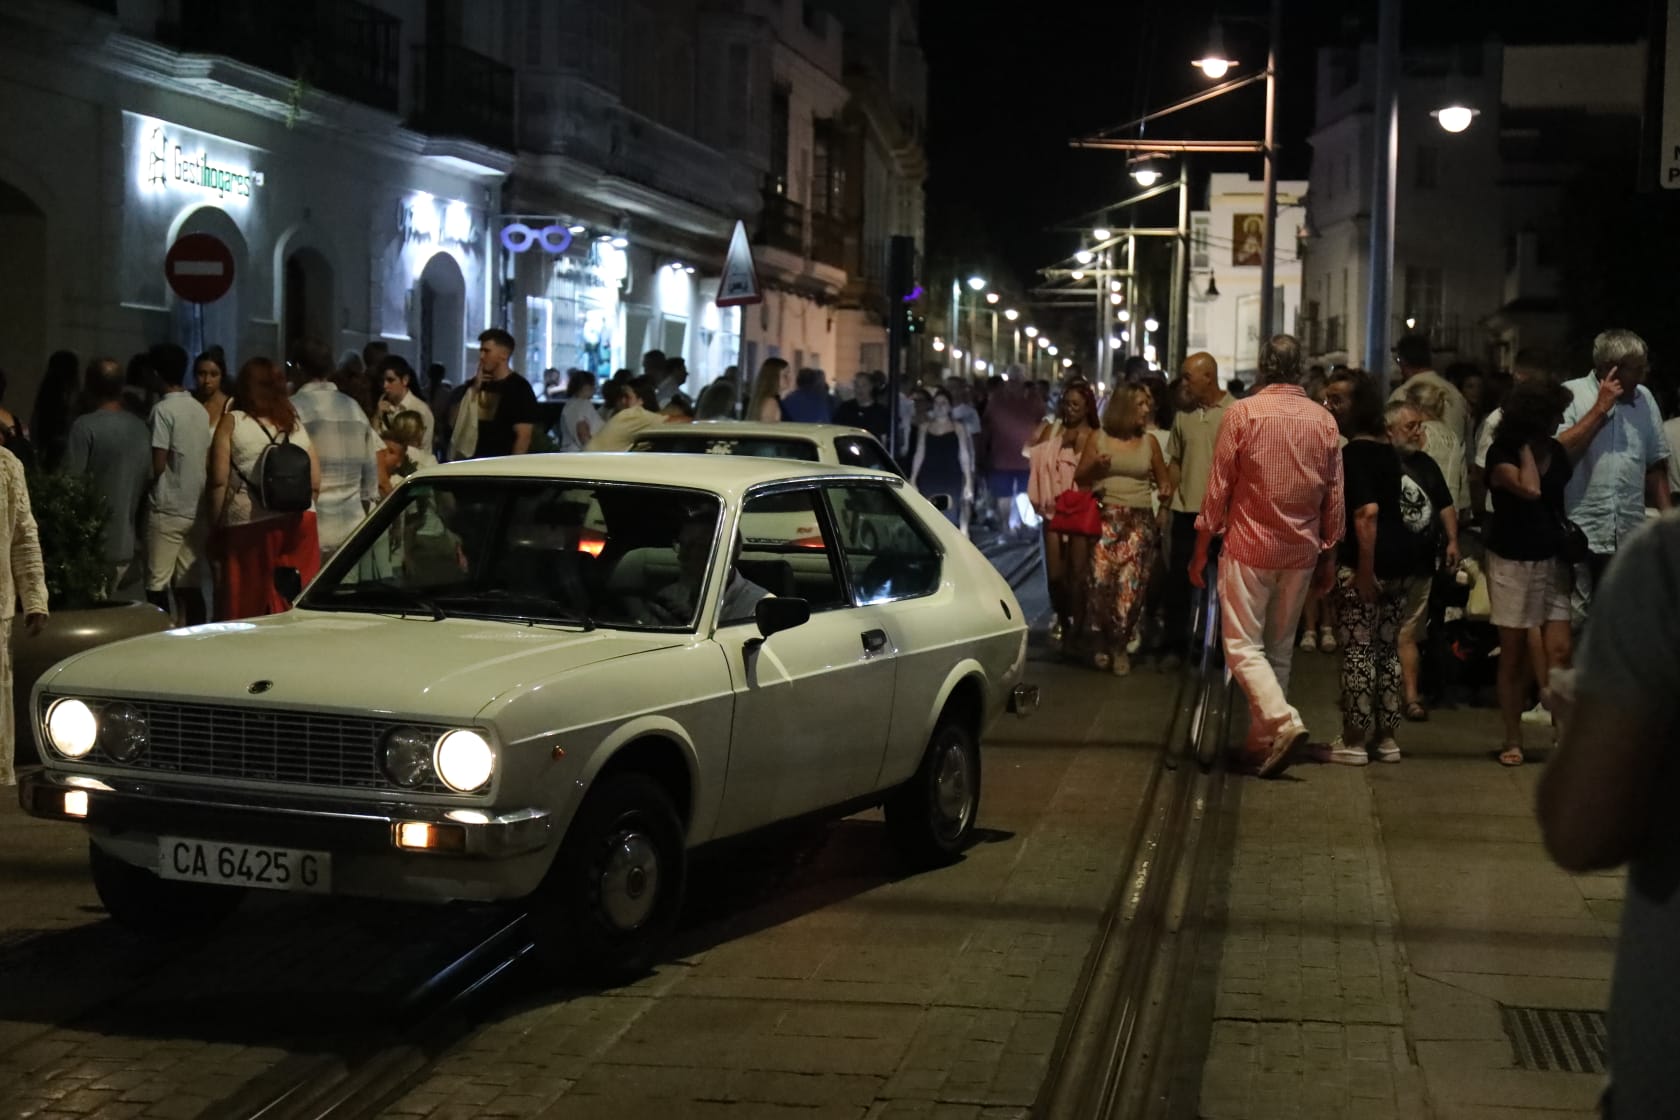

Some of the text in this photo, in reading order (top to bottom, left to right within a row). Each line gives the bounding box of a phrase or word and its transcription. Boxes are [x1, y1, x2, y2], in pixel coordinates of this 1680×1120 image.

[174, 144, 250, 199] Gestihogares
[173, 842, 318, 887] CA 6425 G
